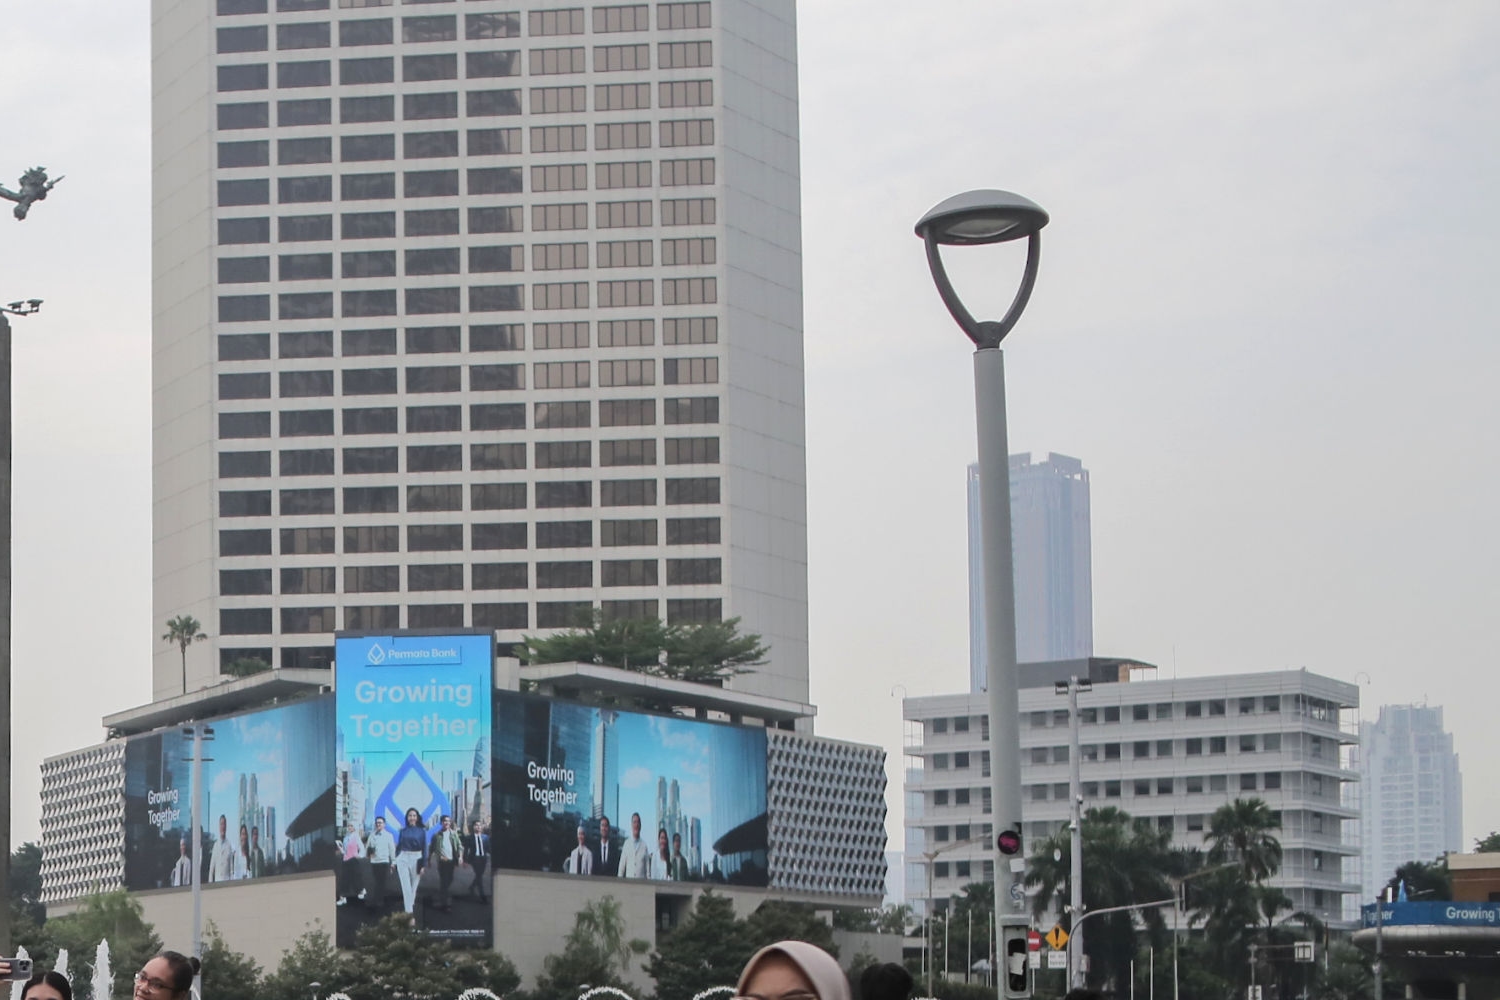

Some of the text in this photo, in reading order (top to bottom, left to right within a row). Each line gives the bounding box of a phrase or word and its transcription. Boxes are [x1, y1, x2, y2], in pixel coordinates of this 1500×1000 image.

[388, 648, 457, 659] Permata Bank
[355, 678, 473, 707] Growing
[350, 712, 477, 743] Together
[528, 761, 574, 785] Growing
[148, 787, 179, 804] Growing
[528, 783, 577, 805] Together
[148, 807, 180, 826] Together
[1446, 906, 1494, 922] Growing
